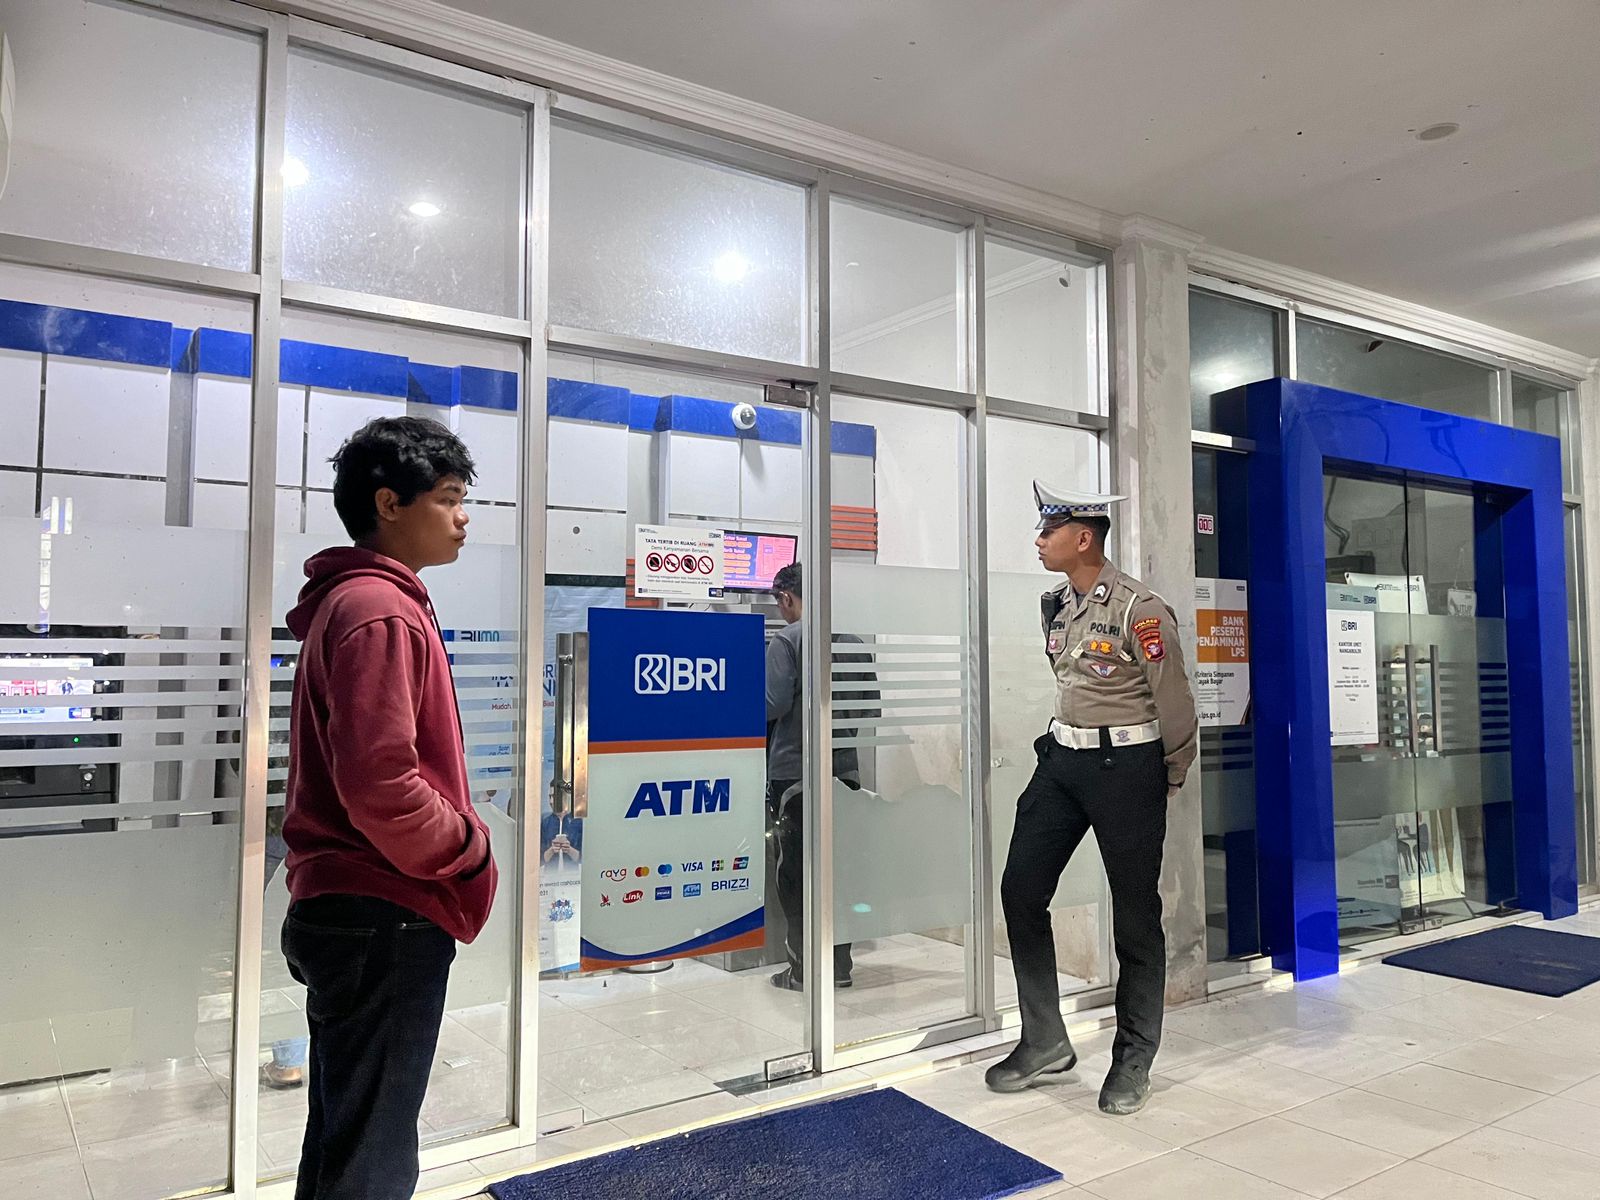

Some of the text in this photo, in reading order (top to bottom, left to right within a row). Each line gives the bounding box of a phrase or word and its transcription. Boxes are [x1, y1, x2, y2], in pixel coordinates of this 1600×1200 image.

[1222, 616, 1245, 626] BANK
[1347, 622, 1358, 631] BRI
[1090, 622, 1121, 637] POLRI
[1210, 626, 1245, 637] PESERTA
[1231, 647, 1246, 657] LPS
[672, 657, 726, 691] BRI
[624, 778, 731, 819] ATM
[681, 862, 704, 872] VISA
[600, 868, 627, 881] raya
[711, 878, 749, 891] BRIZZI
[623, 892, 644, 902] Link
